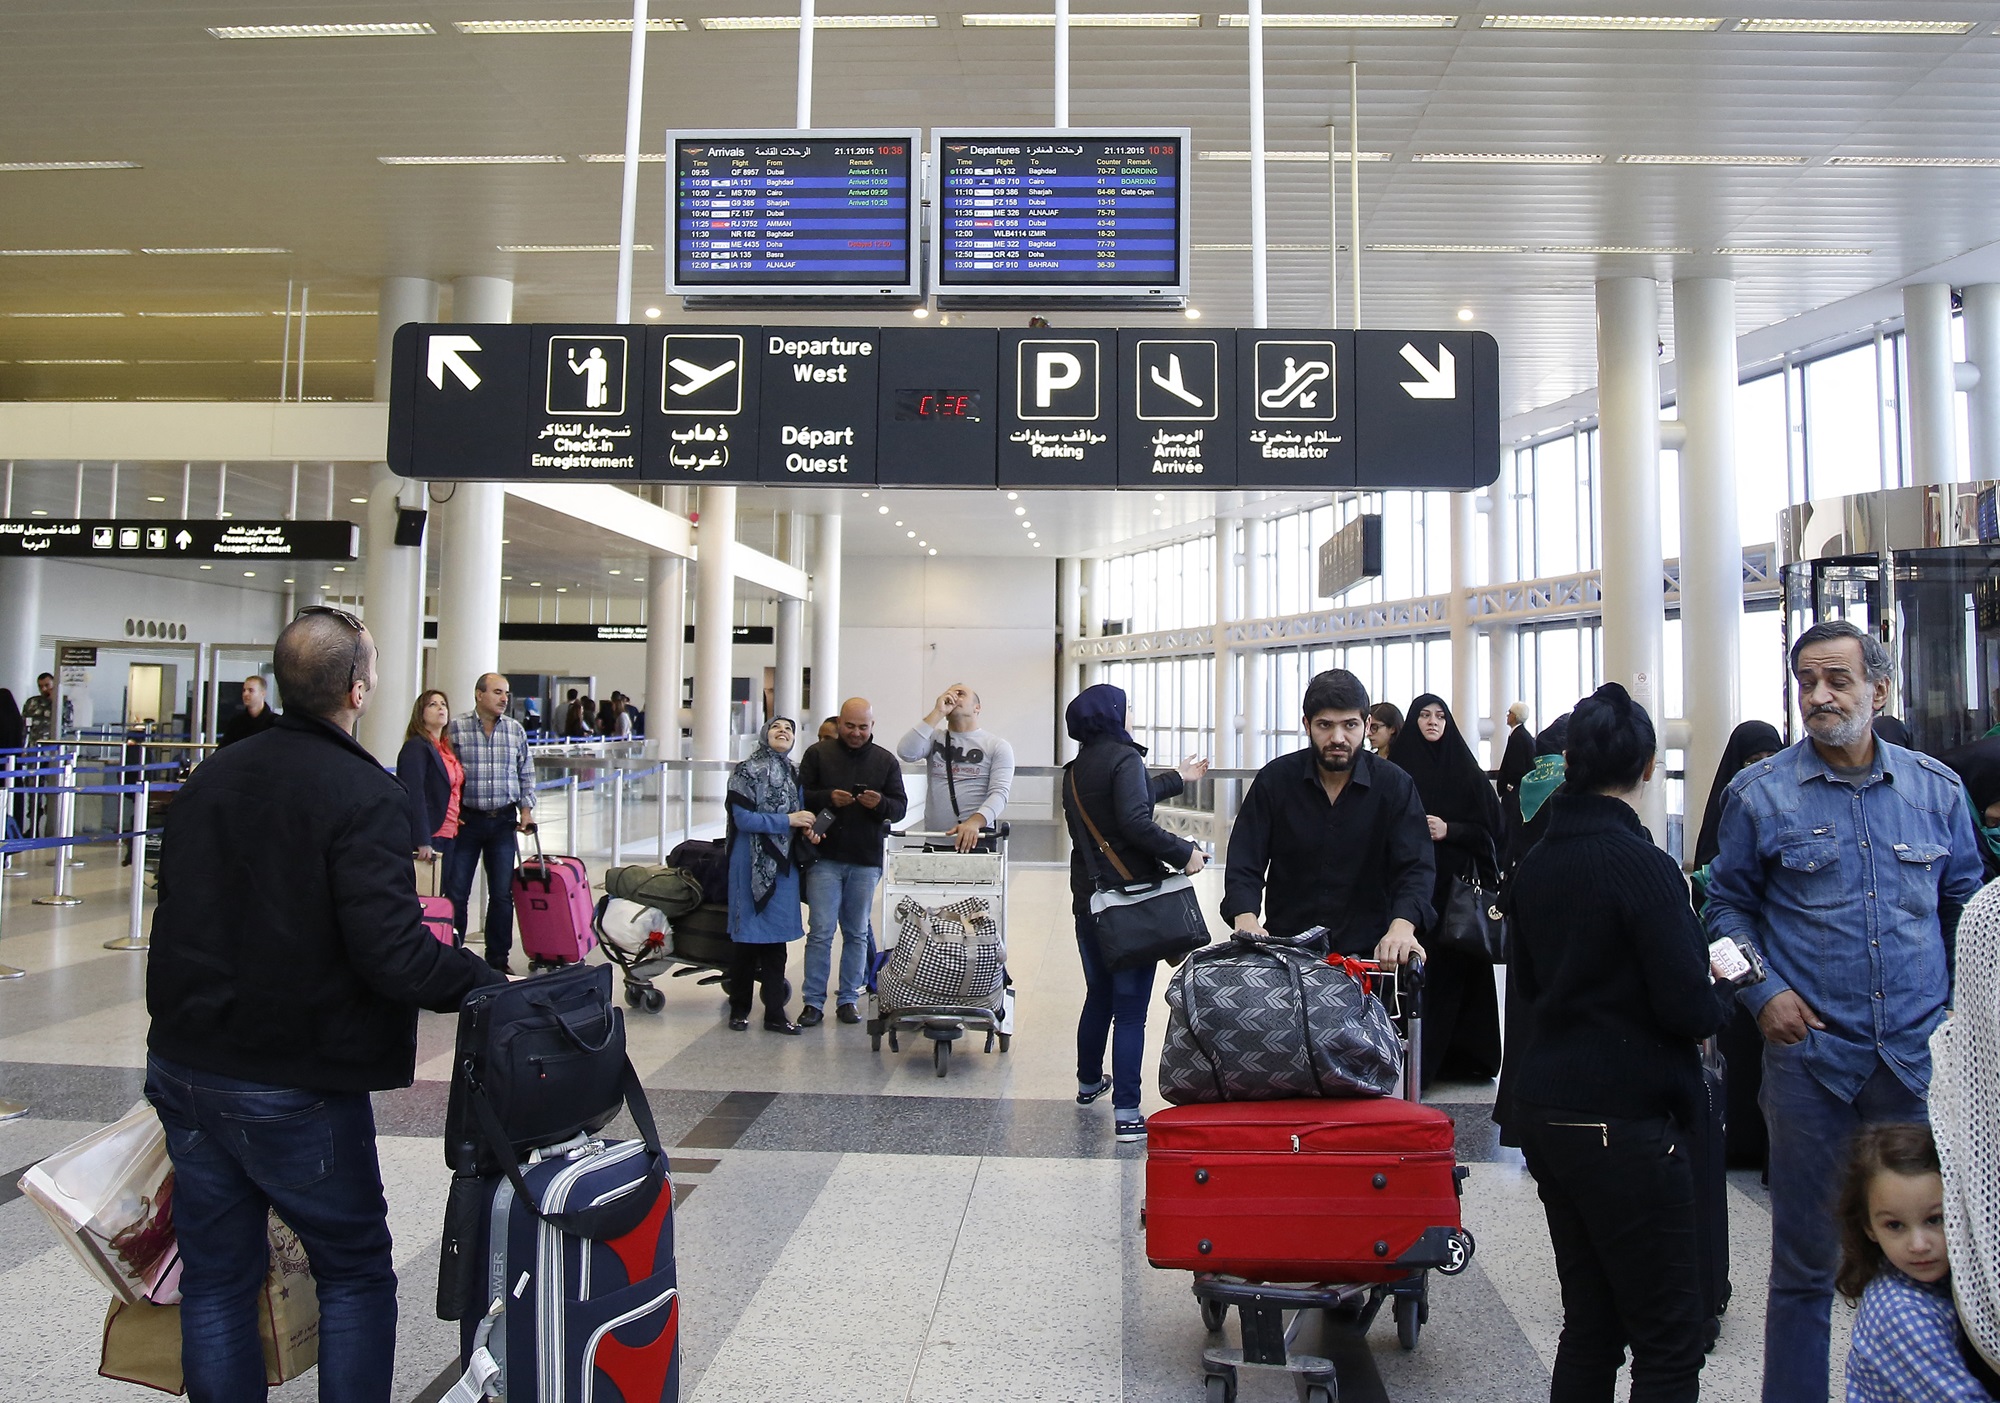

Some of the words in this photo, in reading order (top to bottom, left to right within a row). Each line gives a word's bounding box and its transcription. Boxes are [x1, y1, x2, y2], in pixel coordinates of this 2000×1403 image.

[707, 147, 745, 157] Arrivals
[834, 147, 875, 155] 21.11.2015
[970, 145, 1021, 157] Departures
[1104, 146, 1145, 155] 21.11.2015
[692, 159, 708, 167] Time
[731, 159, 749, 168] Flight
[849, 158, 874, 166] Remark
[995, 158, 1014, 167] Flight
[766, 168, 785, 176] Dubai
[955, 167, 974, 175] 11:00
[1003, 167, 1016, 175] 132
[1028, 167, 1057, 176] Baghdad
[1097, 167, 1116, 175] 70-72
[1121, 167, 1158, 175] BOARDING
[766, 178, 794, 187] Baghdad
[1007, 177, 1020, 185] 710
[691, 189, 710, 197] 10:00
[955, 188, 974, 196] 11:10
[1028, 188, 1053, 197] Sharjah
[1120, 188, 1137, 196] Gate
[1136, 188, 1155, 197] Open
[691, 199, 710, 207] 10:30
[766, 199, 790, 208] Sharjah
[955, 198, 974, 206] 11:25
[1028, 198, 1046, 206] Dubai
[1097, 198, 1116, 206] 13-15
[742, 209, 754, 217] 157
[766, 209, 785, 217] Dubai
[954, 209, 974, 217] 11:35
[691, 220, 710, 228] 11:25
[741, 220, 758, 228] 3752
[955, 219, 974, 227] 12:00
[1028, 219, 1047, 227] Dubai
[691, 230, 710, 238] 11:30
[766, 230, 794, 239] Baghdad
[766, 240, 783, 248] Doha
[954, 240, 973, 248] 12:20
[1006, 240, 1020, 248] 322
[1028, 240, 1057, 249] Baghdad
[691, 251, 710, 259] 12:00
[954, 250, 973, 258] 12:50
[1006, 250, 1020, 258] 425
[691, 261, 710, 269] 12:00
[765, 261, 796, 269] ALNAJAF
[954, 261, 973, 269] 13:00
[1005, 261, 1019, 269] 910
[769, 336, 873, 359] Departure
[793, 363, 848, 383] West
[1036, 352, 1082, 408] P
[537, 423, 582, 439] التذاكر
[583, 423, 632, 439] تسجيل
[671, 423, 729, 445] ذهاب
[781, 425, 854, 450] Départ
[1009, 428, 1060, 445] سيارات
[1060, 428, 1107, 445] مواقف
[1151, 428, 1204, 445] الوصول
[1249, 429, 1302, 446] متحركة
[1304, 430, 1342, 447] سلالم
[553, 438, 614, 452] Check-In
[1031, 443, 1084, 461] Parking
[1153, 443, 1202, 458] Arrival
[1261, 445, 1329, 459] Escalator
[531, 453, 634, 470] Enregistrement
[669, 444, 729, 471] (غرب)
[785, 453, 848, 473] Ouest
[1151, 459, 1204, 474] Arrivée
[265, 534, 285, 545] Only
